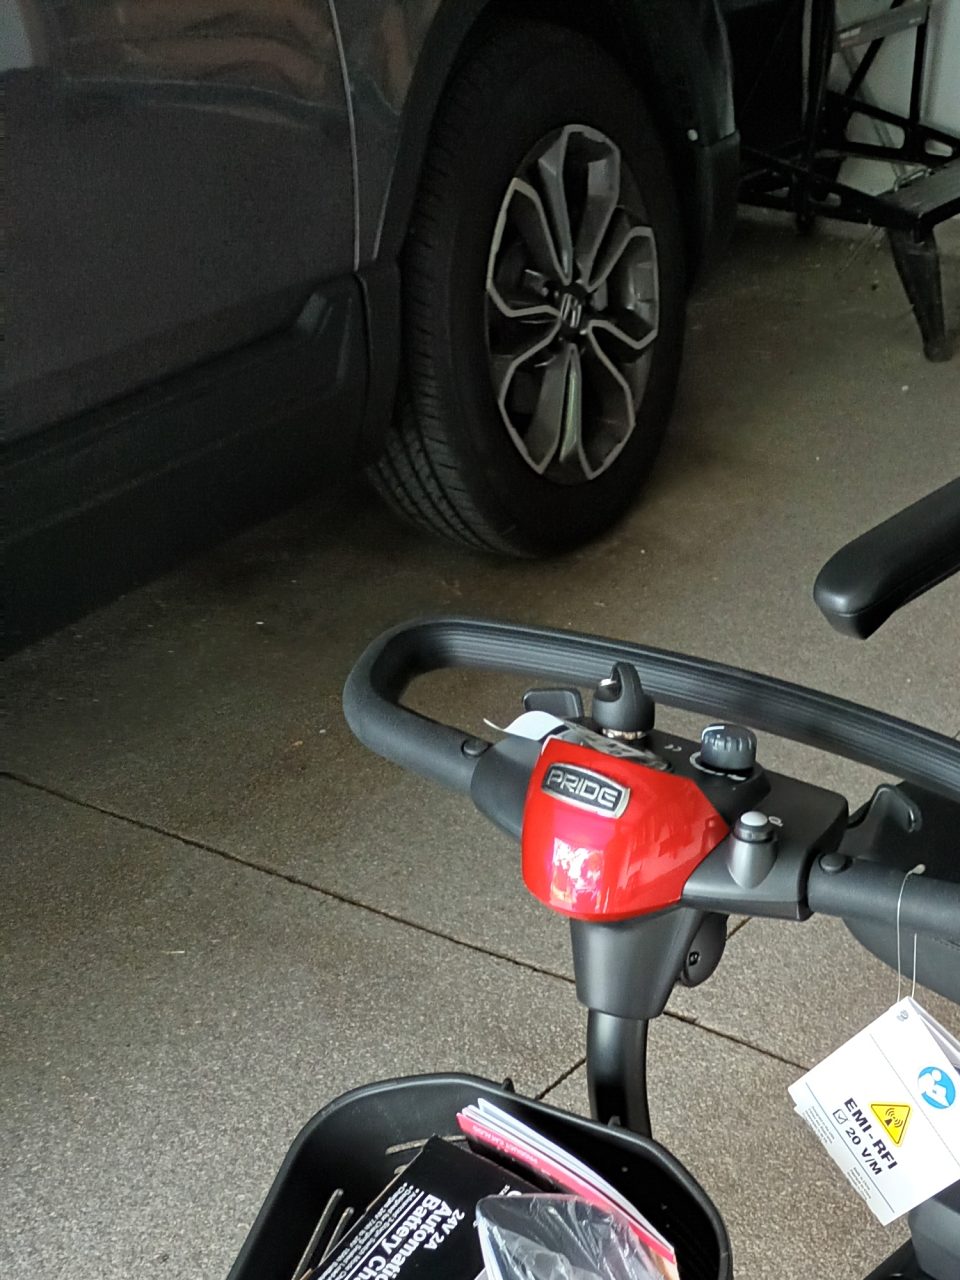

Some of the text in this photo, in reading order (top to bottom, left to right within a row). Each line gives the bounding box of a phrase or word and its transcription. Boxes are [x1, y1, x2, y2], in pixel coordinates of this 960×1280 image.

[547, 769, 618, 808] PRIDE
[845, 1127, 862, 1146] 20
[861, 1147, 883, 1176] V/M
[381, 1194, 441, 1256] Battery
[423, 1209, 465, 1249] 24V 2A
